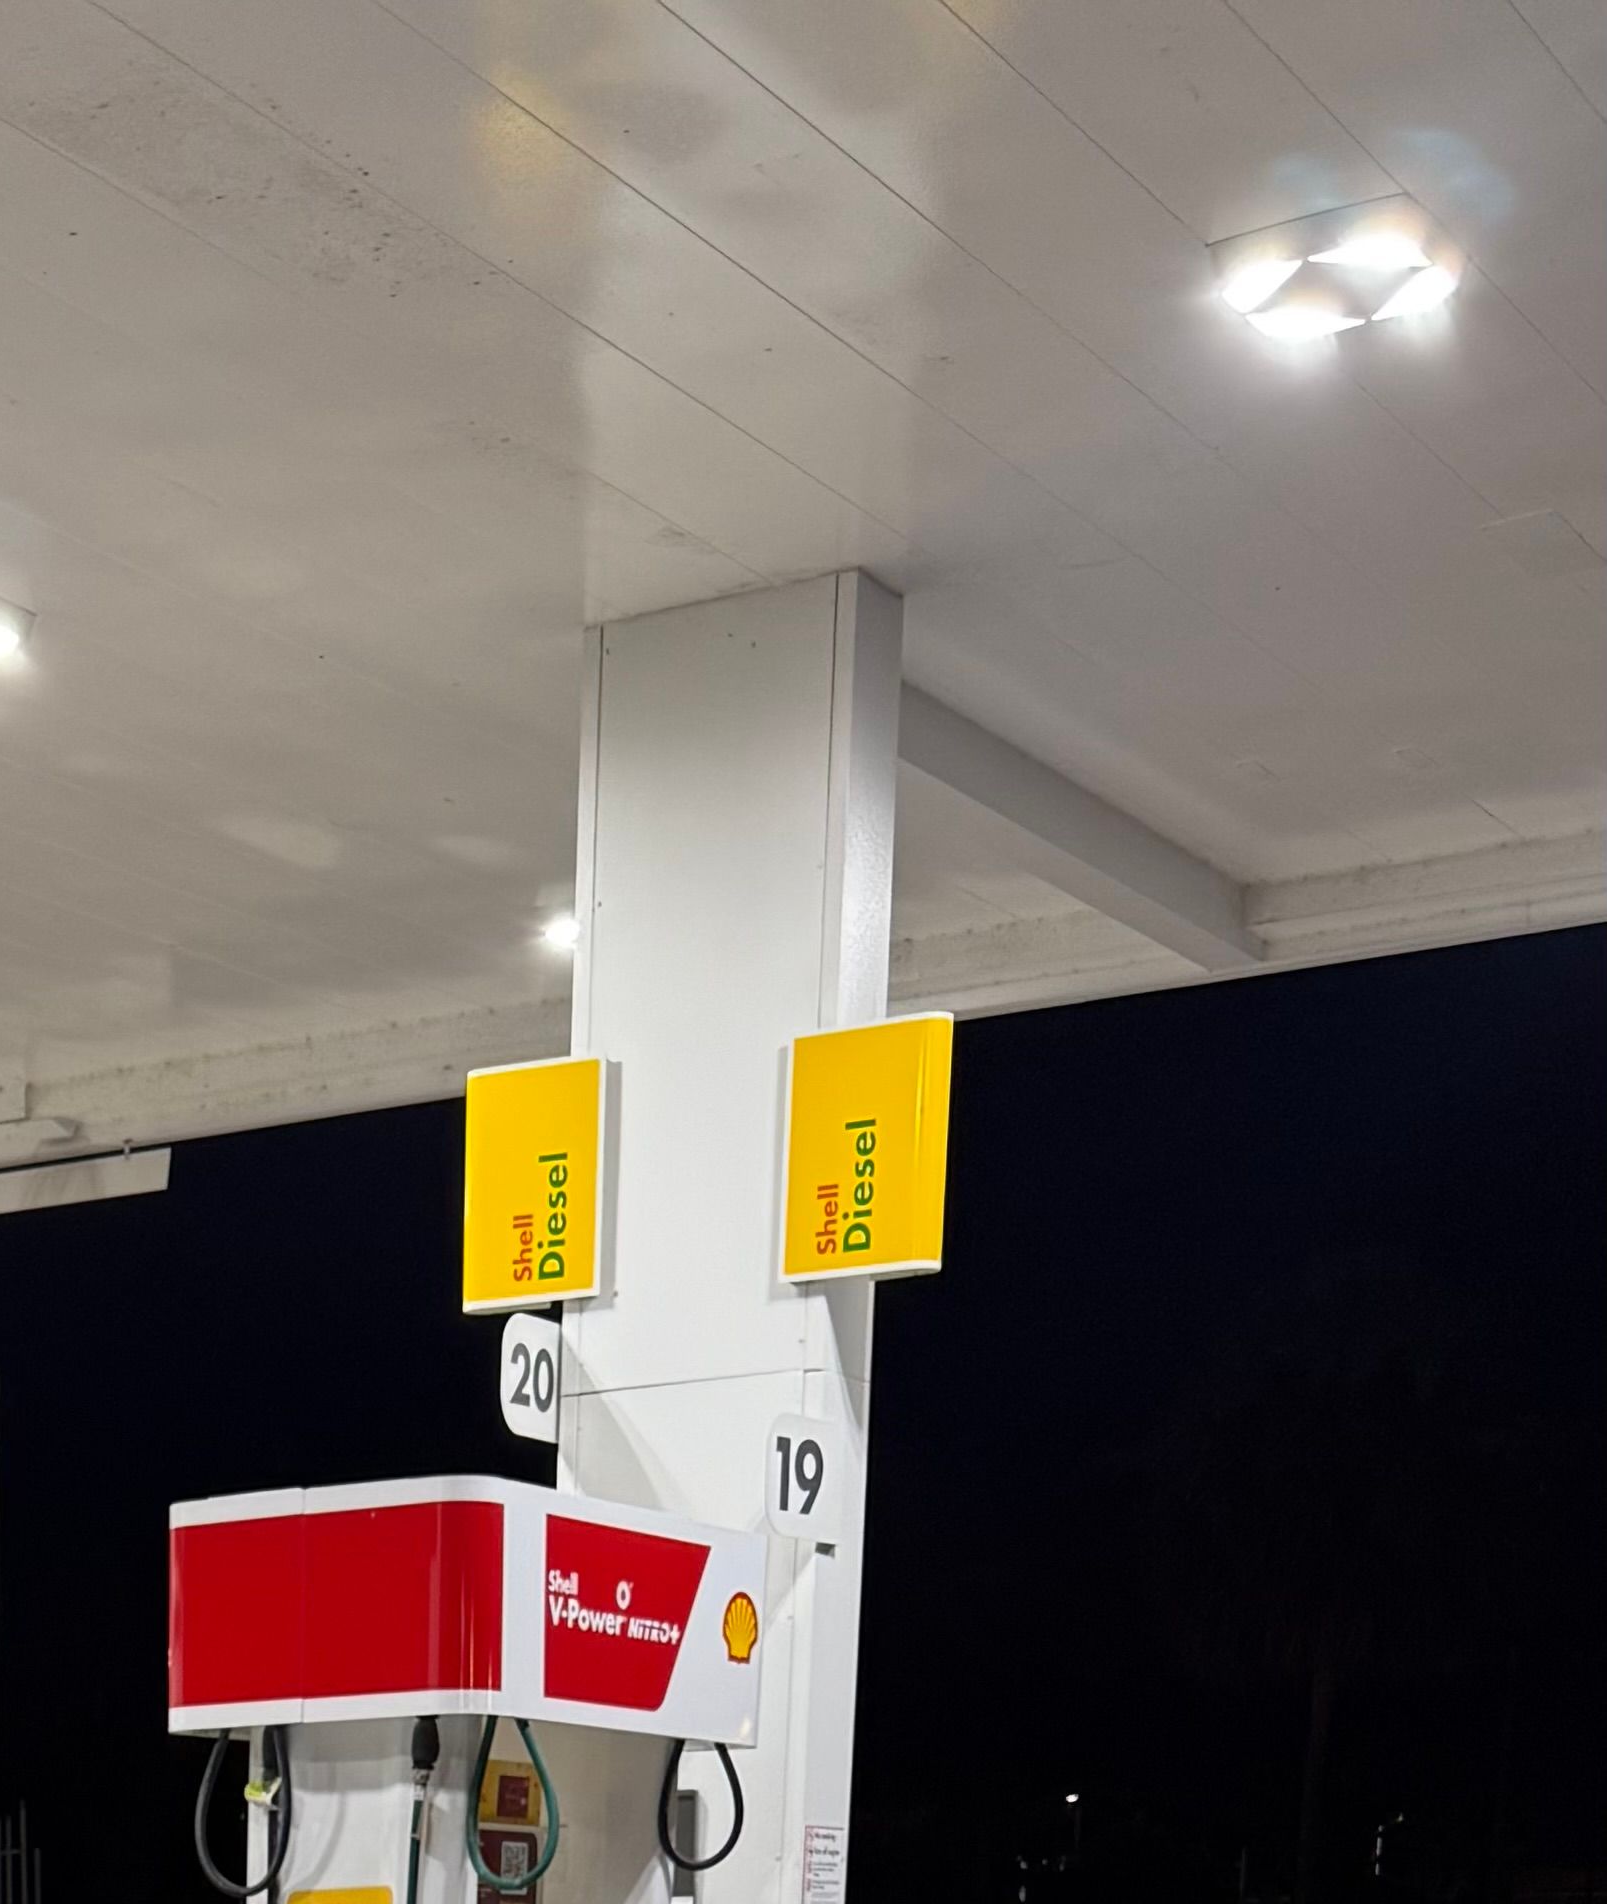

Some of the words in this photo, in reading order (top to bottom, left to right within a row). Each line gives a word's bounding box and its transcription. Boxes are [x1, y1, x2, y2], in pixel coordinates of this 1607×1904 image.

[537, 1152, 569, 1281] Diesel
[814, 1183, 839, 1256] Shell
[842, 1118, 877, 1254] Diesel
[513, 1213, 534, 1282] Shell
[510, 1342, 555, 1413] 20
[775, 1436, 824, 1516] 19
[548, 1569, 579, 1596] Shell
[548, 1594, 627, 1637] V-Power
